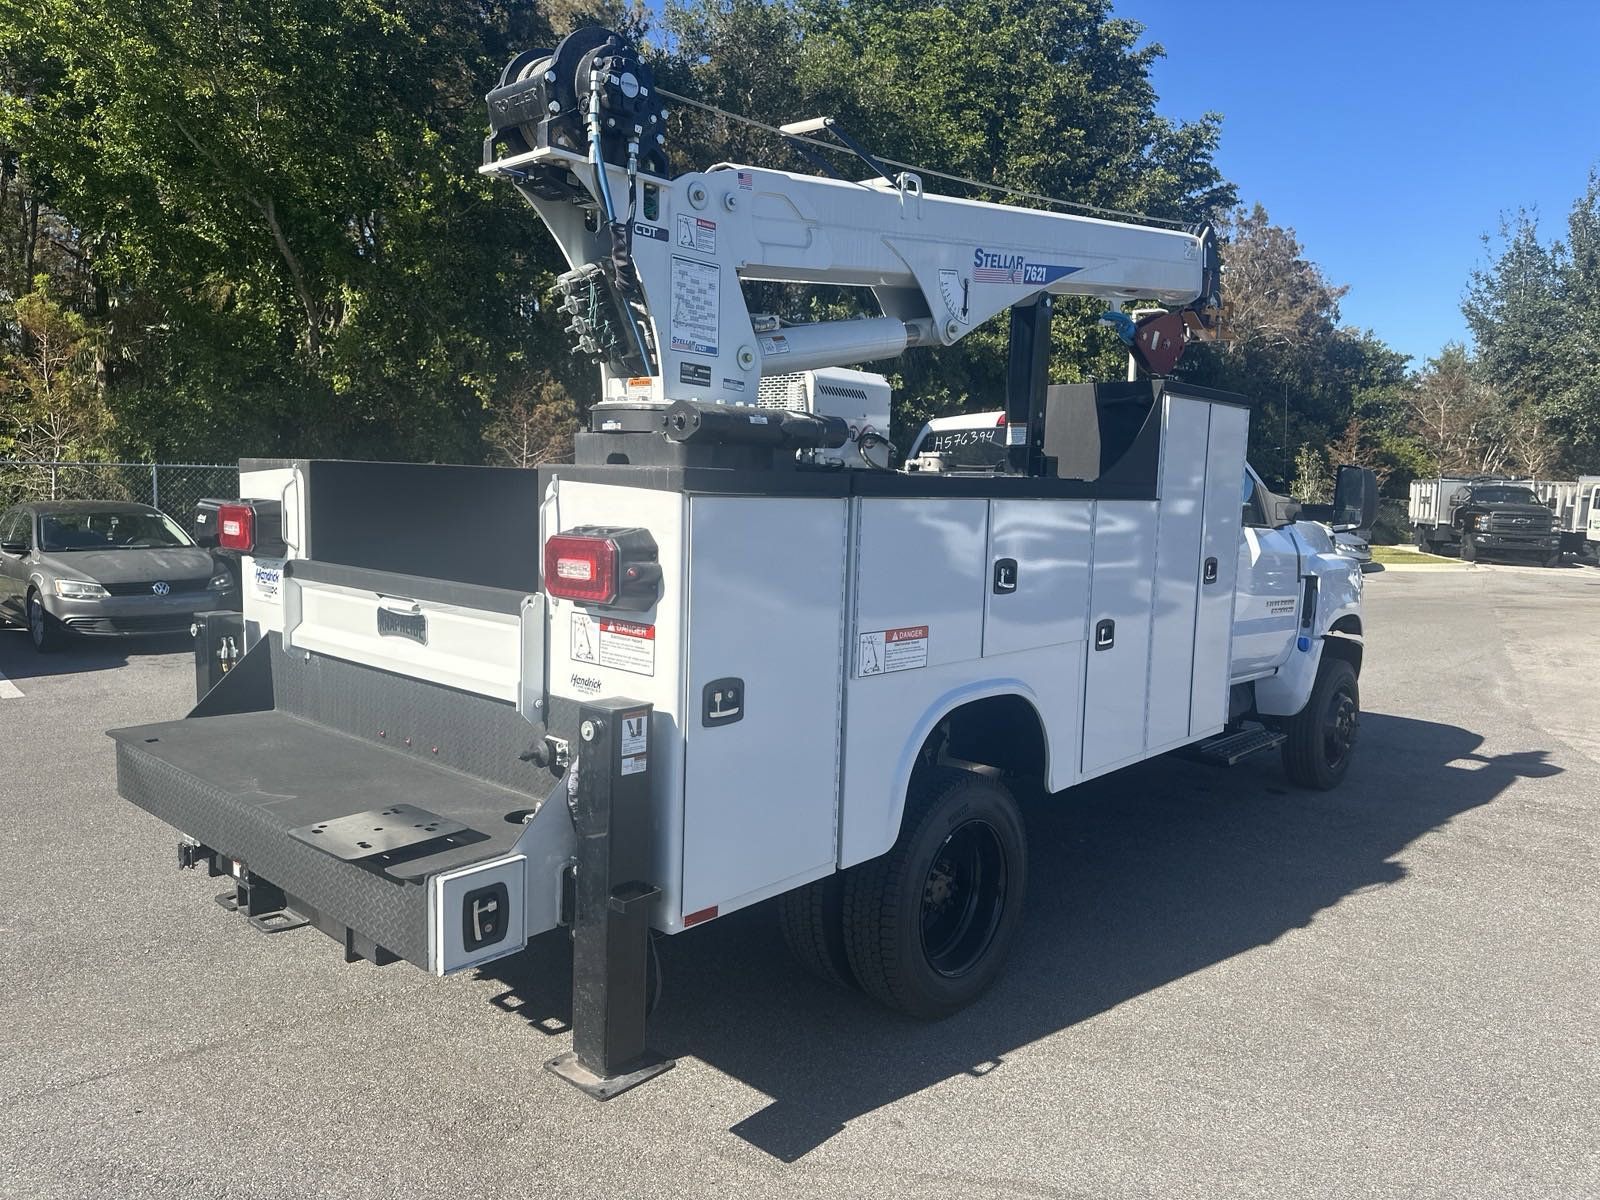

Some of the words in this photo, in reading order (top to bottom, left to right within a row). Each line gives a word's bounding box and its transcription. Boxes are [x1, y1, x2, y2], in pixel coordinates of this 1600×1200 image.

[634, 223, 659, 238] CDT
[973, 248, 1024, 270] STELLAR
[1025, 266, 1047, 282] 7621
[934, 431, 995, 450] H576394
[616, 623, 647, 635] DANGER
[899, 629, 923, 639] DANGER
[570, 673, 602, 688] Hendrick
